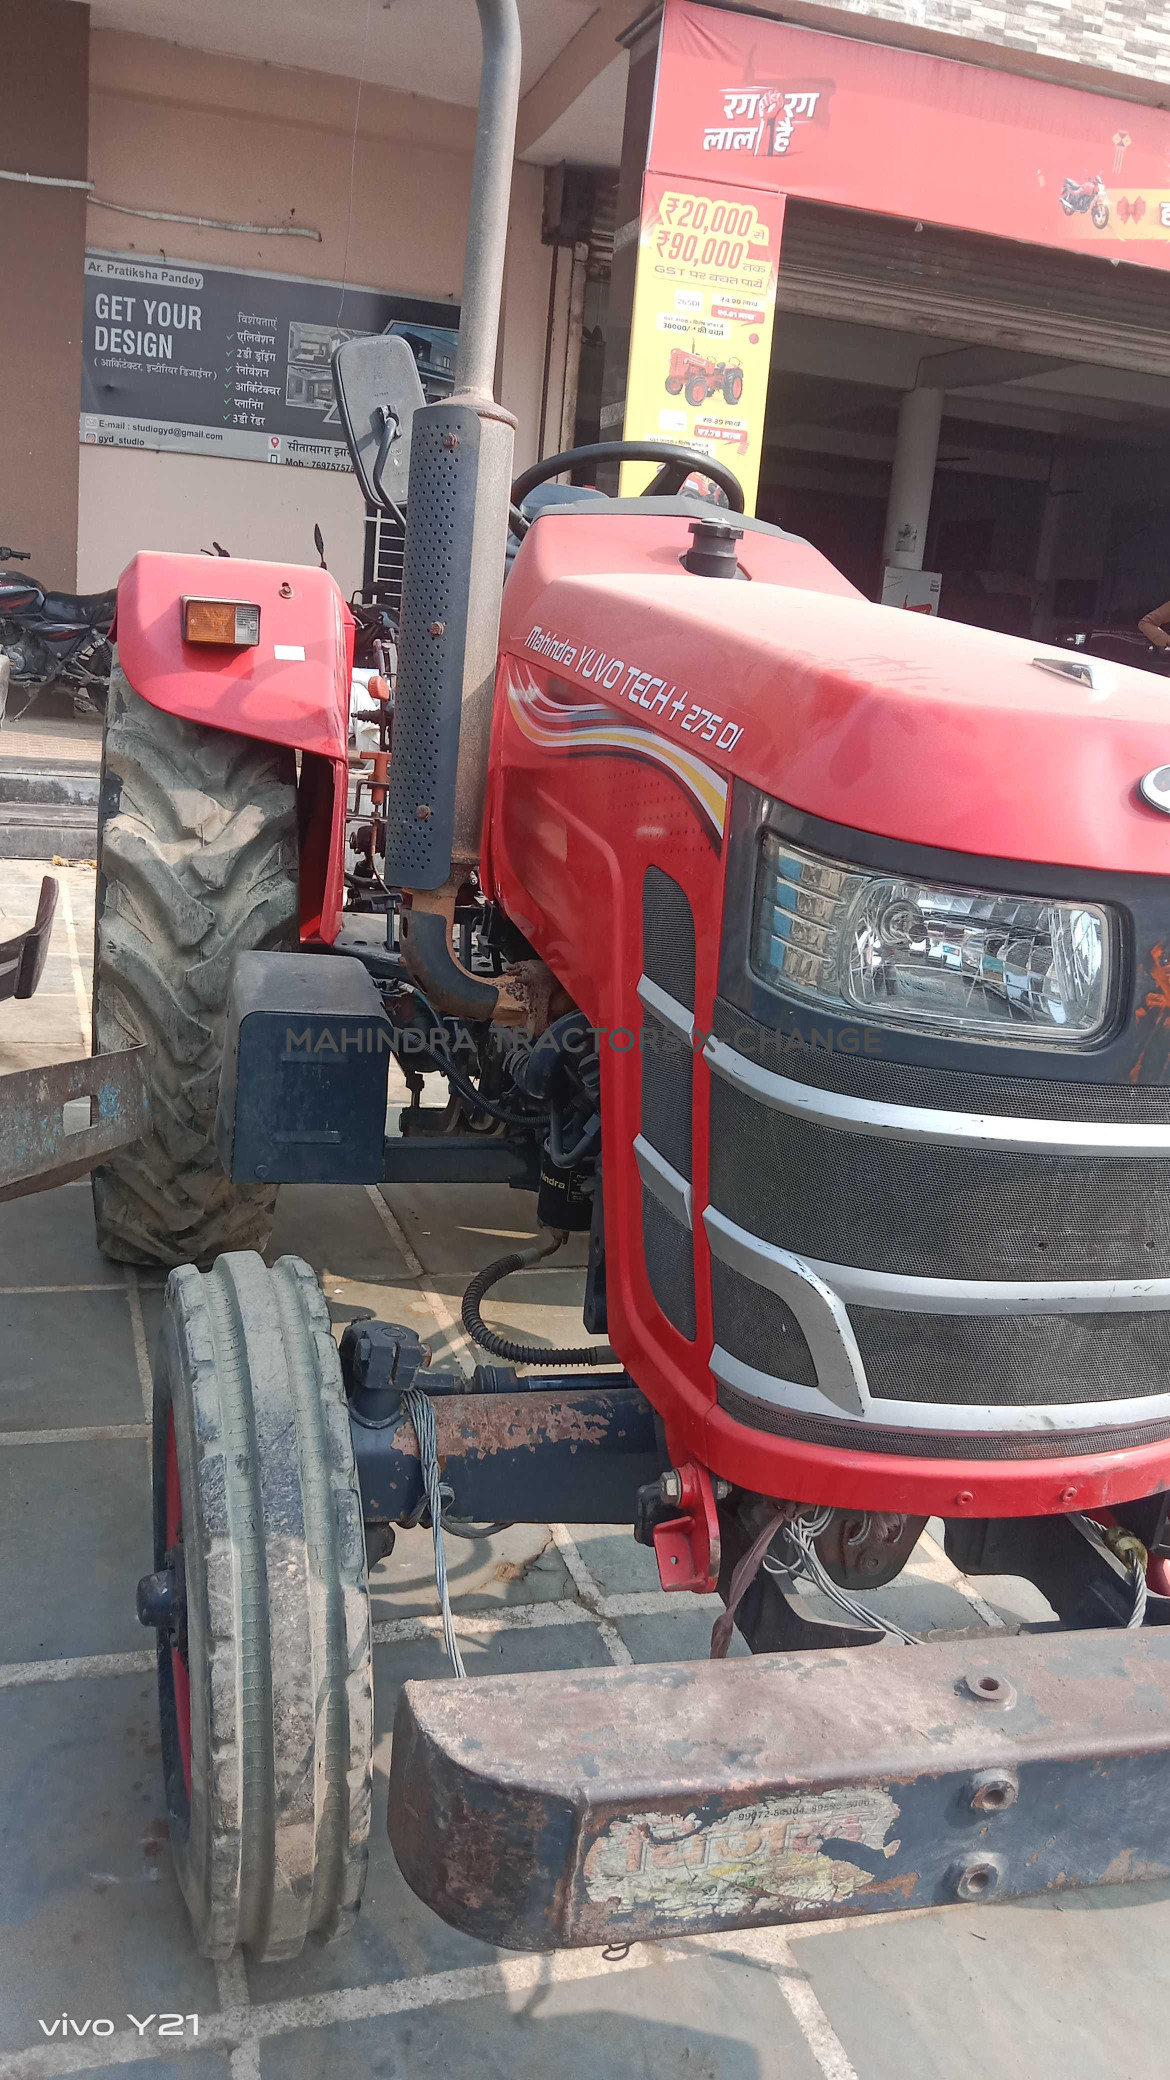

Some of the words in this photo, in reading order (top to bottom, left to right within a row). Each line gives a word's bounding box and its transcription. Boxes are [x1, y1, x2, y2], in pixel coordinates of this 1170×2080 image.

[723, 93, 761, 120] रग
[783, 92, 820, 118] रग
[703, 127, 758, 151] लाल
[773, 116, 794, 153] है
[665, 197, 753, 237] ₹20,000
[656, 230, 744, 269] ₹90,000
[88, 261, 103, 273] Ar.
[107, 264, 158, 280] Pratiksha
[161, 271, 201, 288] Pandey
[654, 265, 686, 277] GST
[95, 293, 136, 322] GET
[143, 299, 202, 331] YOUR
[94, 326, 173, 359] DESIGN
[98, 435, 145, 446] gyd_studio
[99, 420, 125, 430] E-mail
[132, 425, 223, 441] studiogyd@gmail.com
[524, 625, 577, 667] Mahindra
[575, 645, 625, 689] YUVO
[620, 666, 677, 716] TECH
[680, 704, 724, 742] 275
[715, 721, 745, 753] DI
